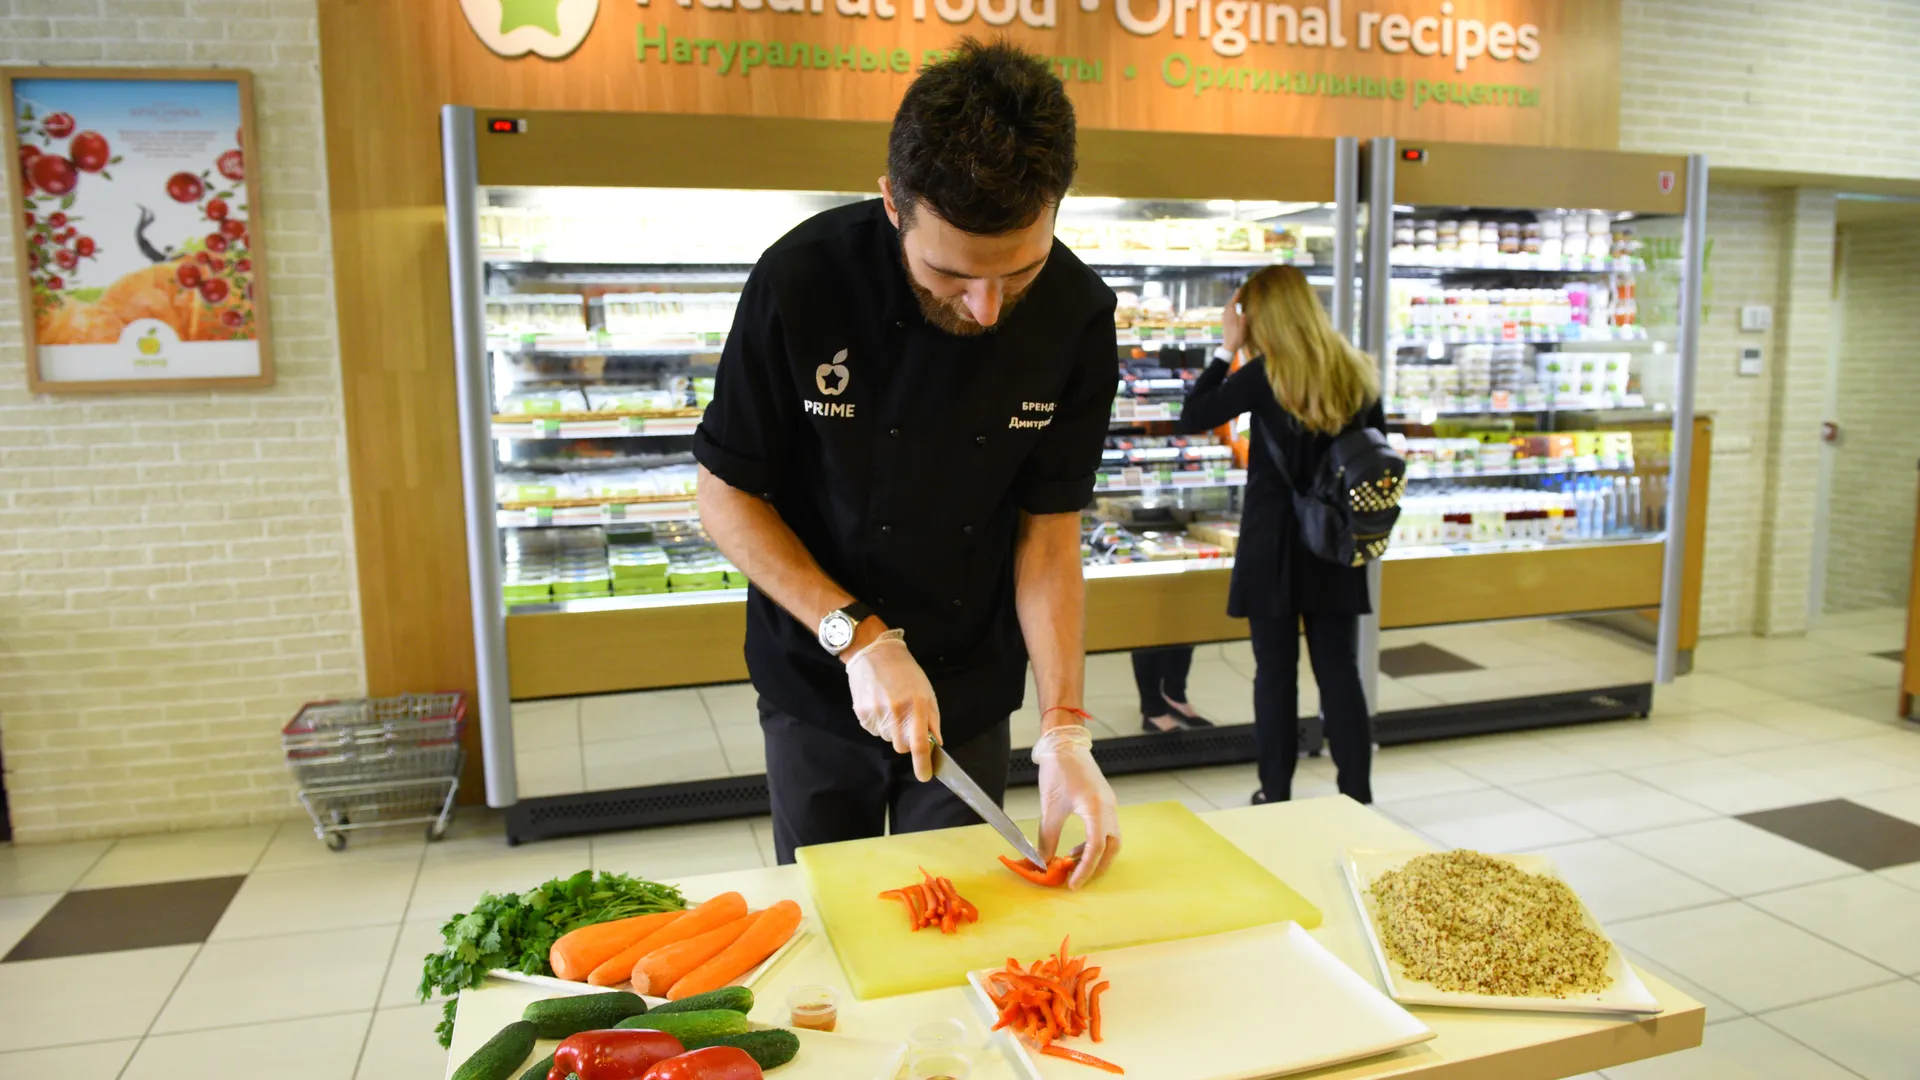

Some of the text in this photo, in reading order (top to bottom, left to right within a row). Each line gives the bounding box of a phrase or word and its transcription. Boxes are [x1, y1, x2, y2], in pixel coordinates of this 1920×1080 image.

[636, 22, 911, 76] Натуральные
[1162, 52, 1407, 100] Оригинальные
[1414, 78, 1541, 108] рецепты
[1115, 0, 1347, 57] Original
[1358, 0, 1541, 72] recipes
[804, 399, 856, 418] PRIME
